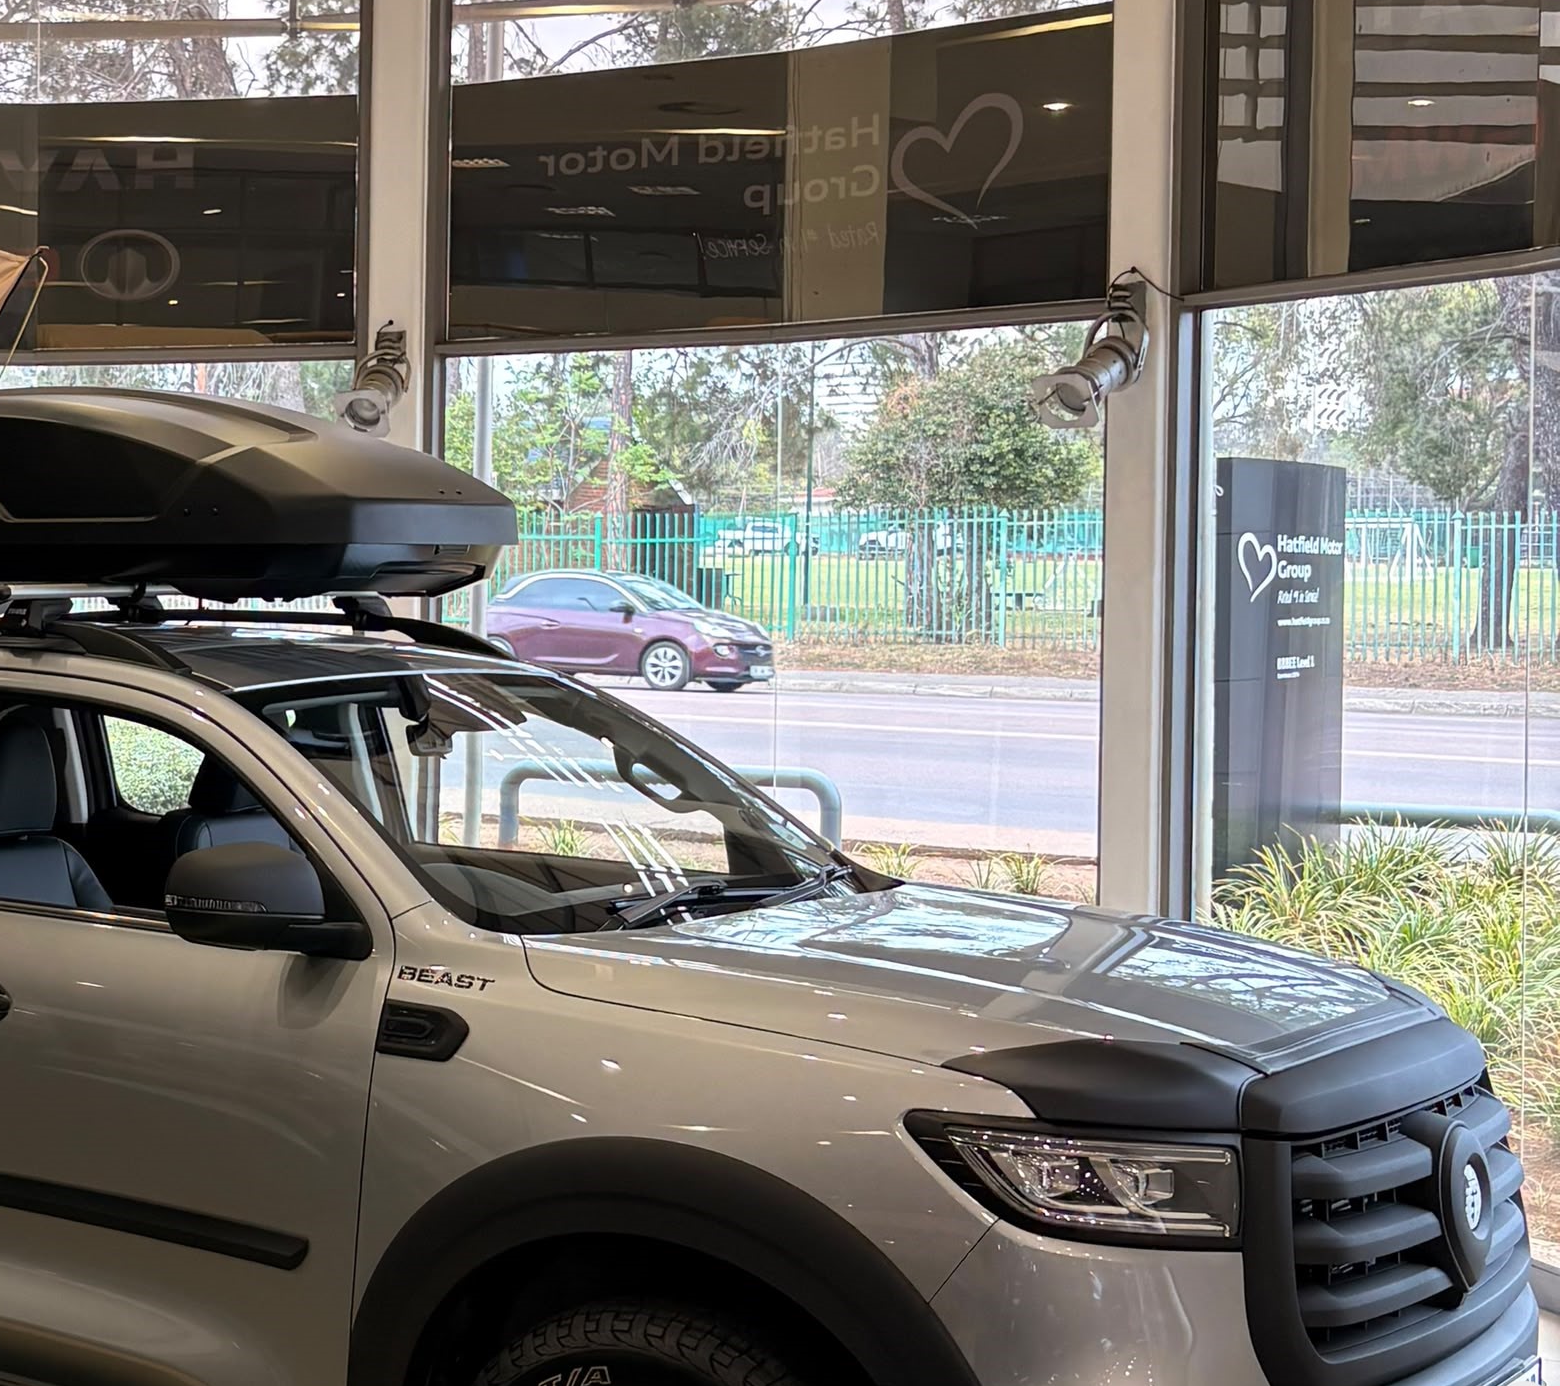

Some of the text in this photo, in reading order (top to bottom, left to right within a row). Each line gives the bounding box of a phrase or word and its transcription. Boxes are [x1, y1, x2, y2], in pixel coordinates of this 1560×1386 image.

[1277, 534, 1343, 556] Hatfield Motor
[1277, 560, 1312, 583] Group
[397, 965, 496, 992] BEAST
